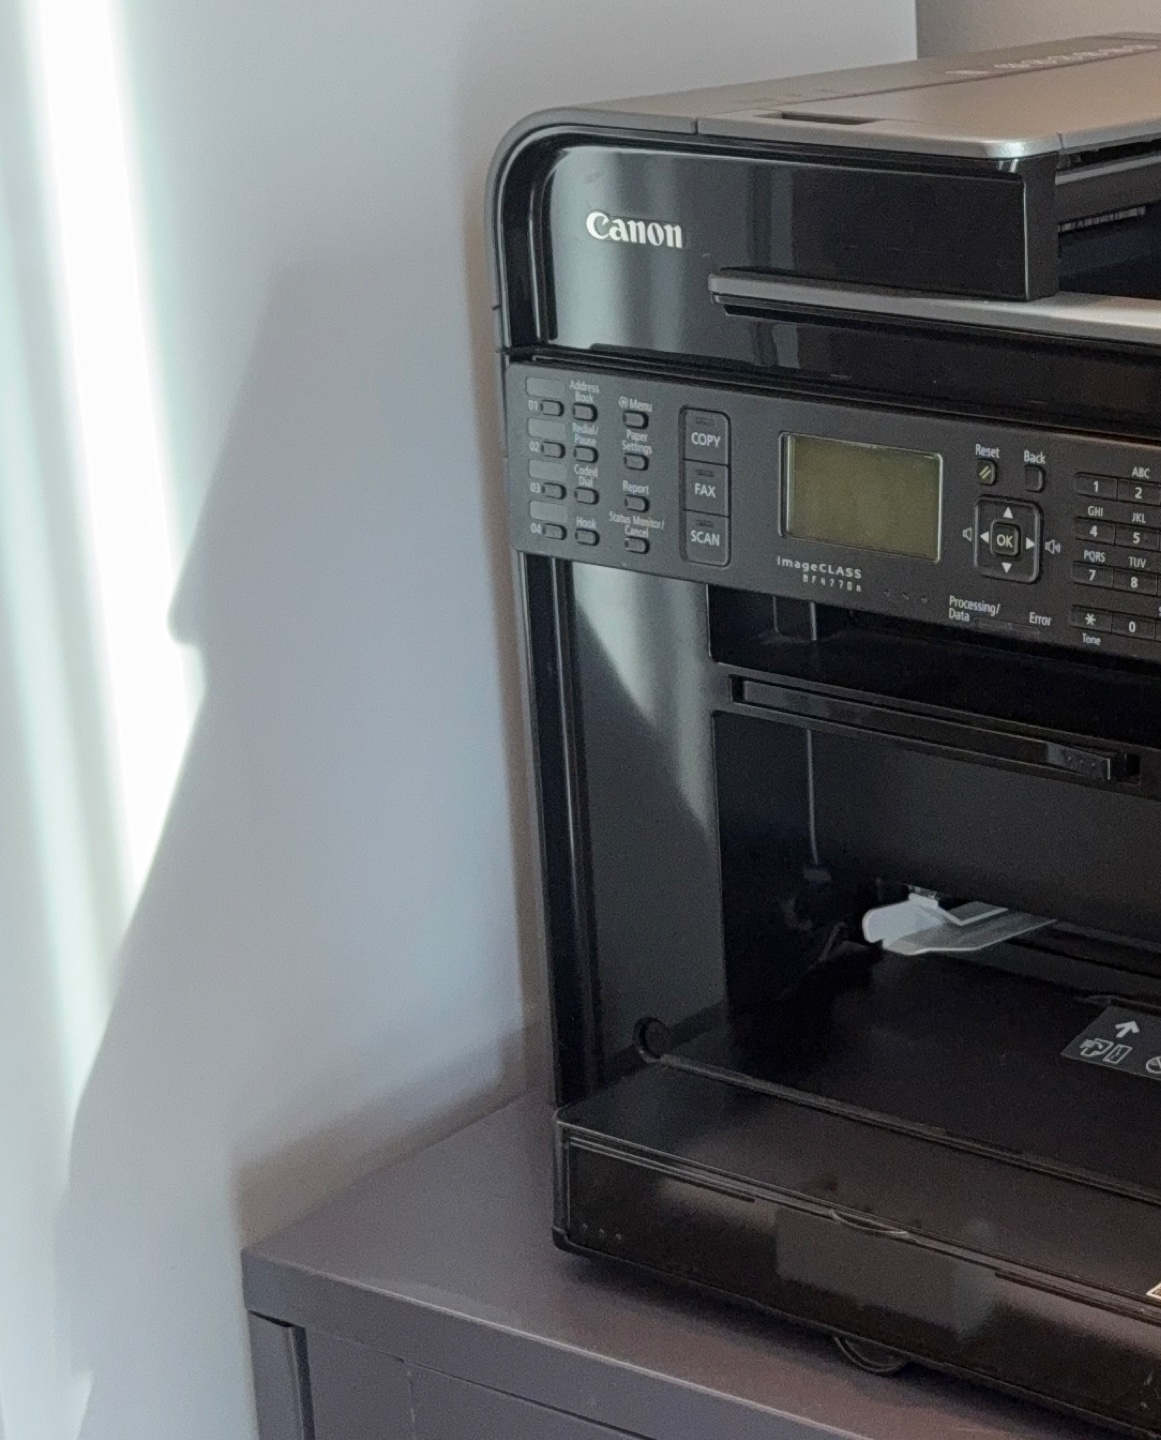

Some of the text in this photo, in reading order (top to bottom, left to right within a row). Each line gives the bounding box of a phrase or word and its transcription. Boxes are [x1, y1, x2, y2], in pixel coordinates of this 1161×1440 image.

[586, 211, 683, 249] Canon
[527, 399, 538, 410] 01
[627, 429, 648, 443] Paper
[691, 432, 721, 448] COPY
[529, 441, 540, 452] 02
[975, 443, 1000, 459] Reset
[1023, 449, 1046, 465] Back
[1132, 466, 1150, 479] ABC
[530, 482, 541, 493] 03
[623, 480, 649, 494] Report
[694, 483, 717, 499] FAX
[1093, 480, 1099, 492] 1
[1135, 487, 1142, 499] 2
[609, 511, 631, 524] Status
[1087, 505, 1103, 517] GHI
[1131, 513, 1146, 524] JKL
[530, 523, 542, 534] 04
[625, 524, 649, 538] Cancel
[1089, 525, 1098, 537] 4
[691, 531, 720, 547] SCAN
[996, 533, 1014, 548] OK
[1132, 532, 1141, 544] 5
[1084, 550, 1106, 563] PQRS
[1128, 556, 1147, 568] TUV
[1088, 569, 1097, 581] 7
[1130, 576, 1138, 588] 8
[949, 607, 970, 623] Data
[1028, 612, 1052, 627] Error
[1128, 621, 1136, 633] 0
